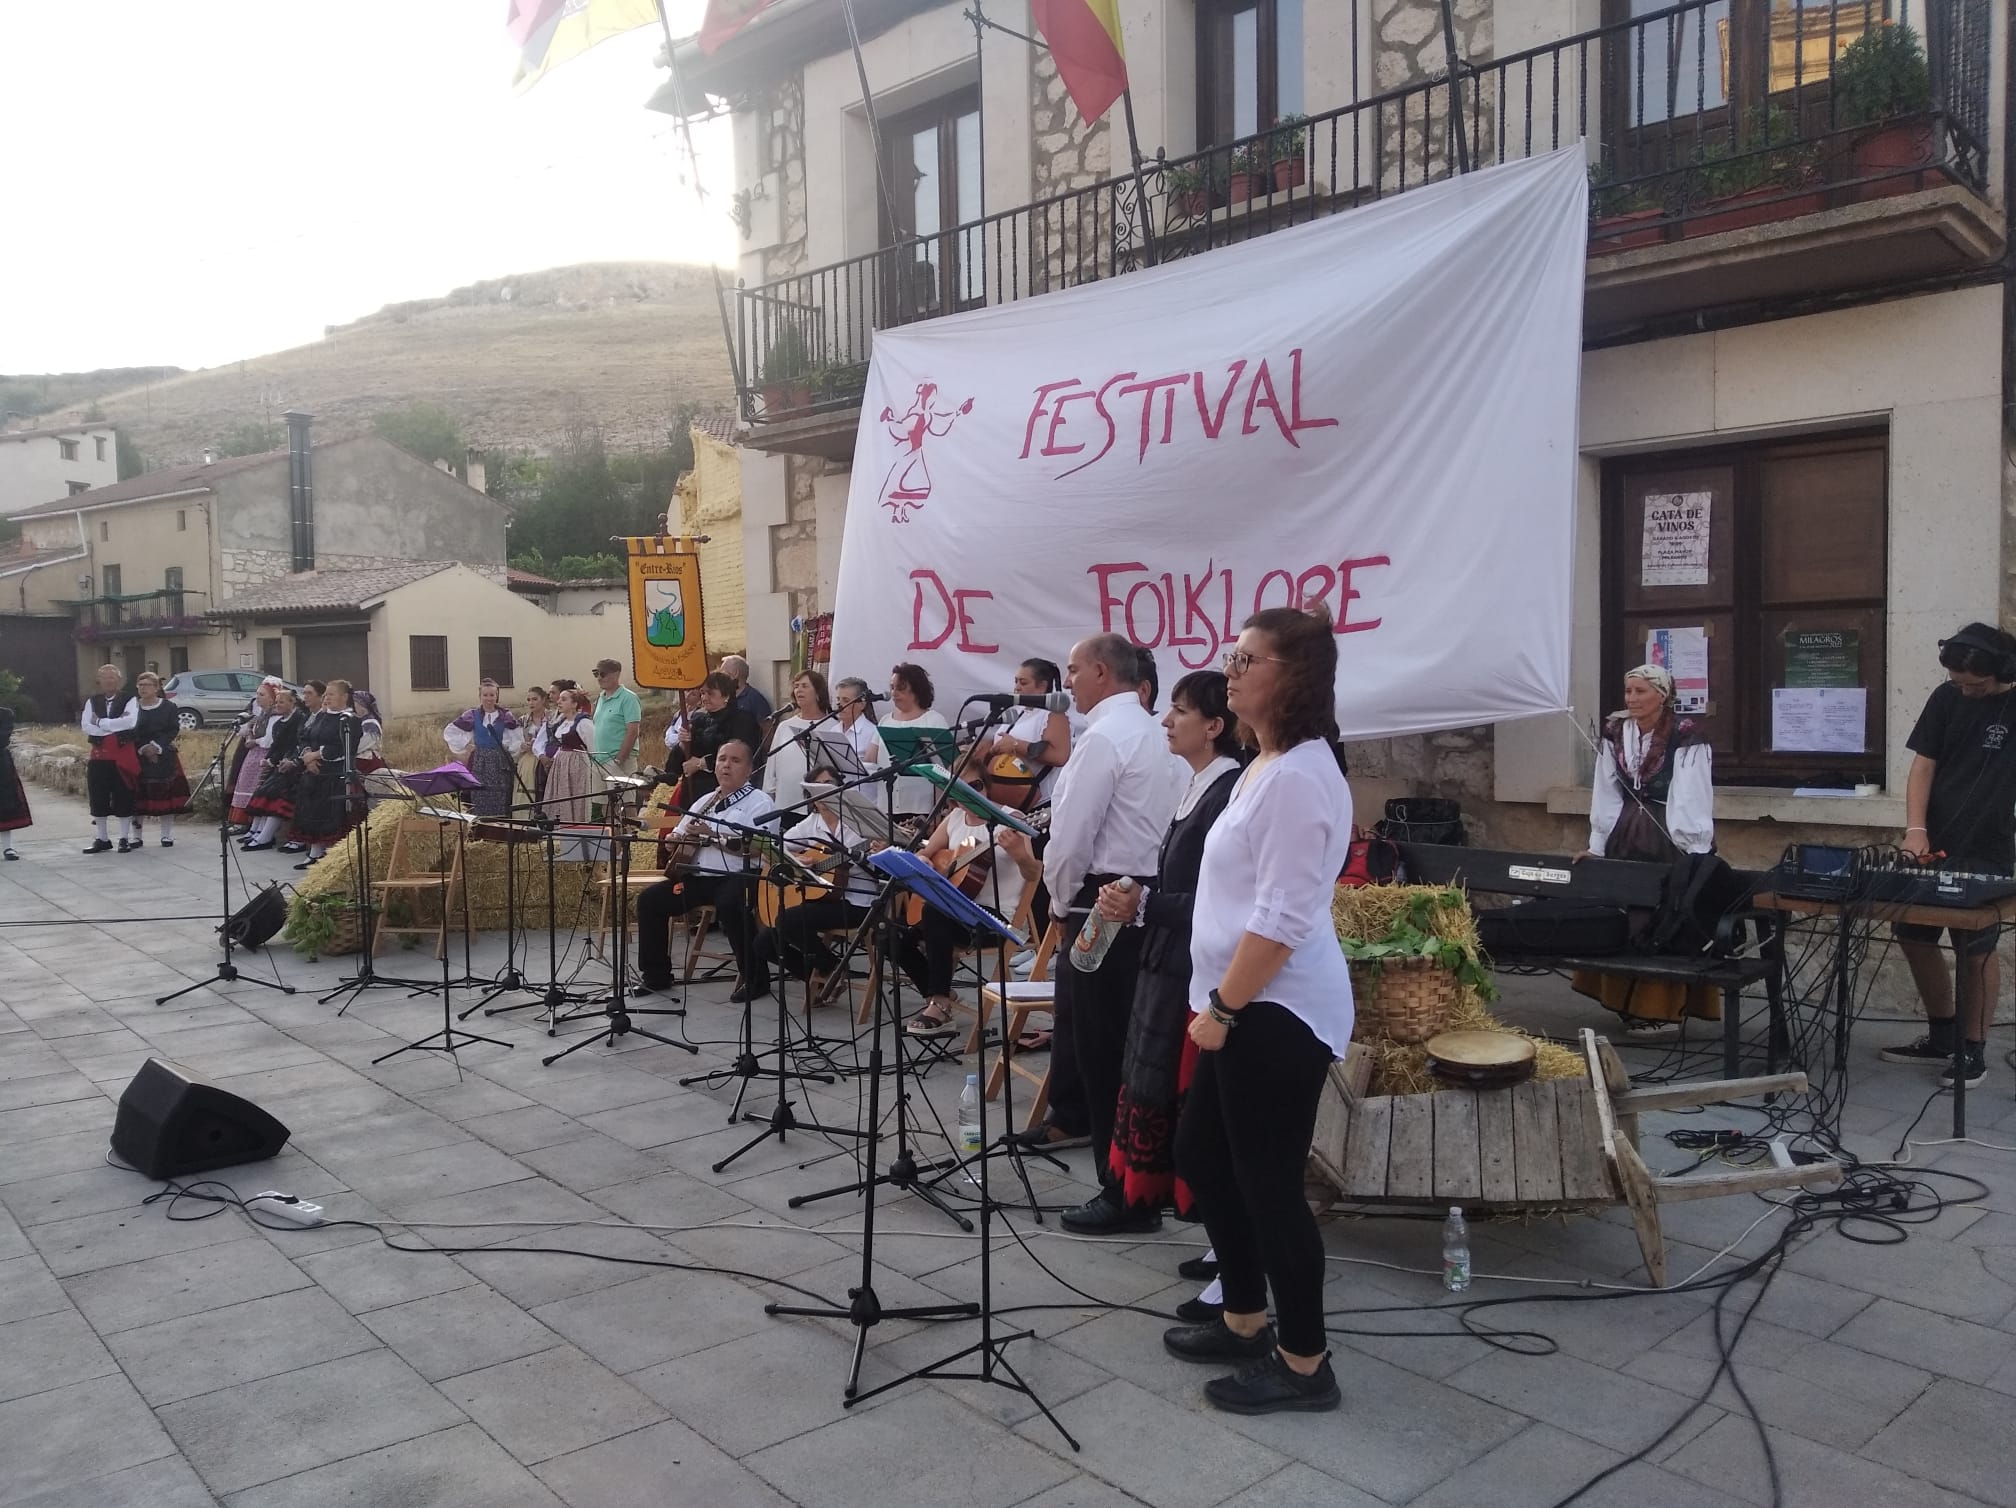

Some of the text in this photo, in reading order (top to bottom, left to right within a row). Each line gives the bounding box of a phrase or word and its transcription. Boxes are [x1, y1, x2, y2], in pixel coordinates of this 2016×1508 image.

[1018, 348, 1339, 481] FESTIVAL
[1651, 508, 1703, 521] CATA DE
[1657, 521, 1695, 532] VINOS
[907, 556, 1391, 669] DE FOLKLORE
[1799, 635, 1843, 644] MILAGROS
